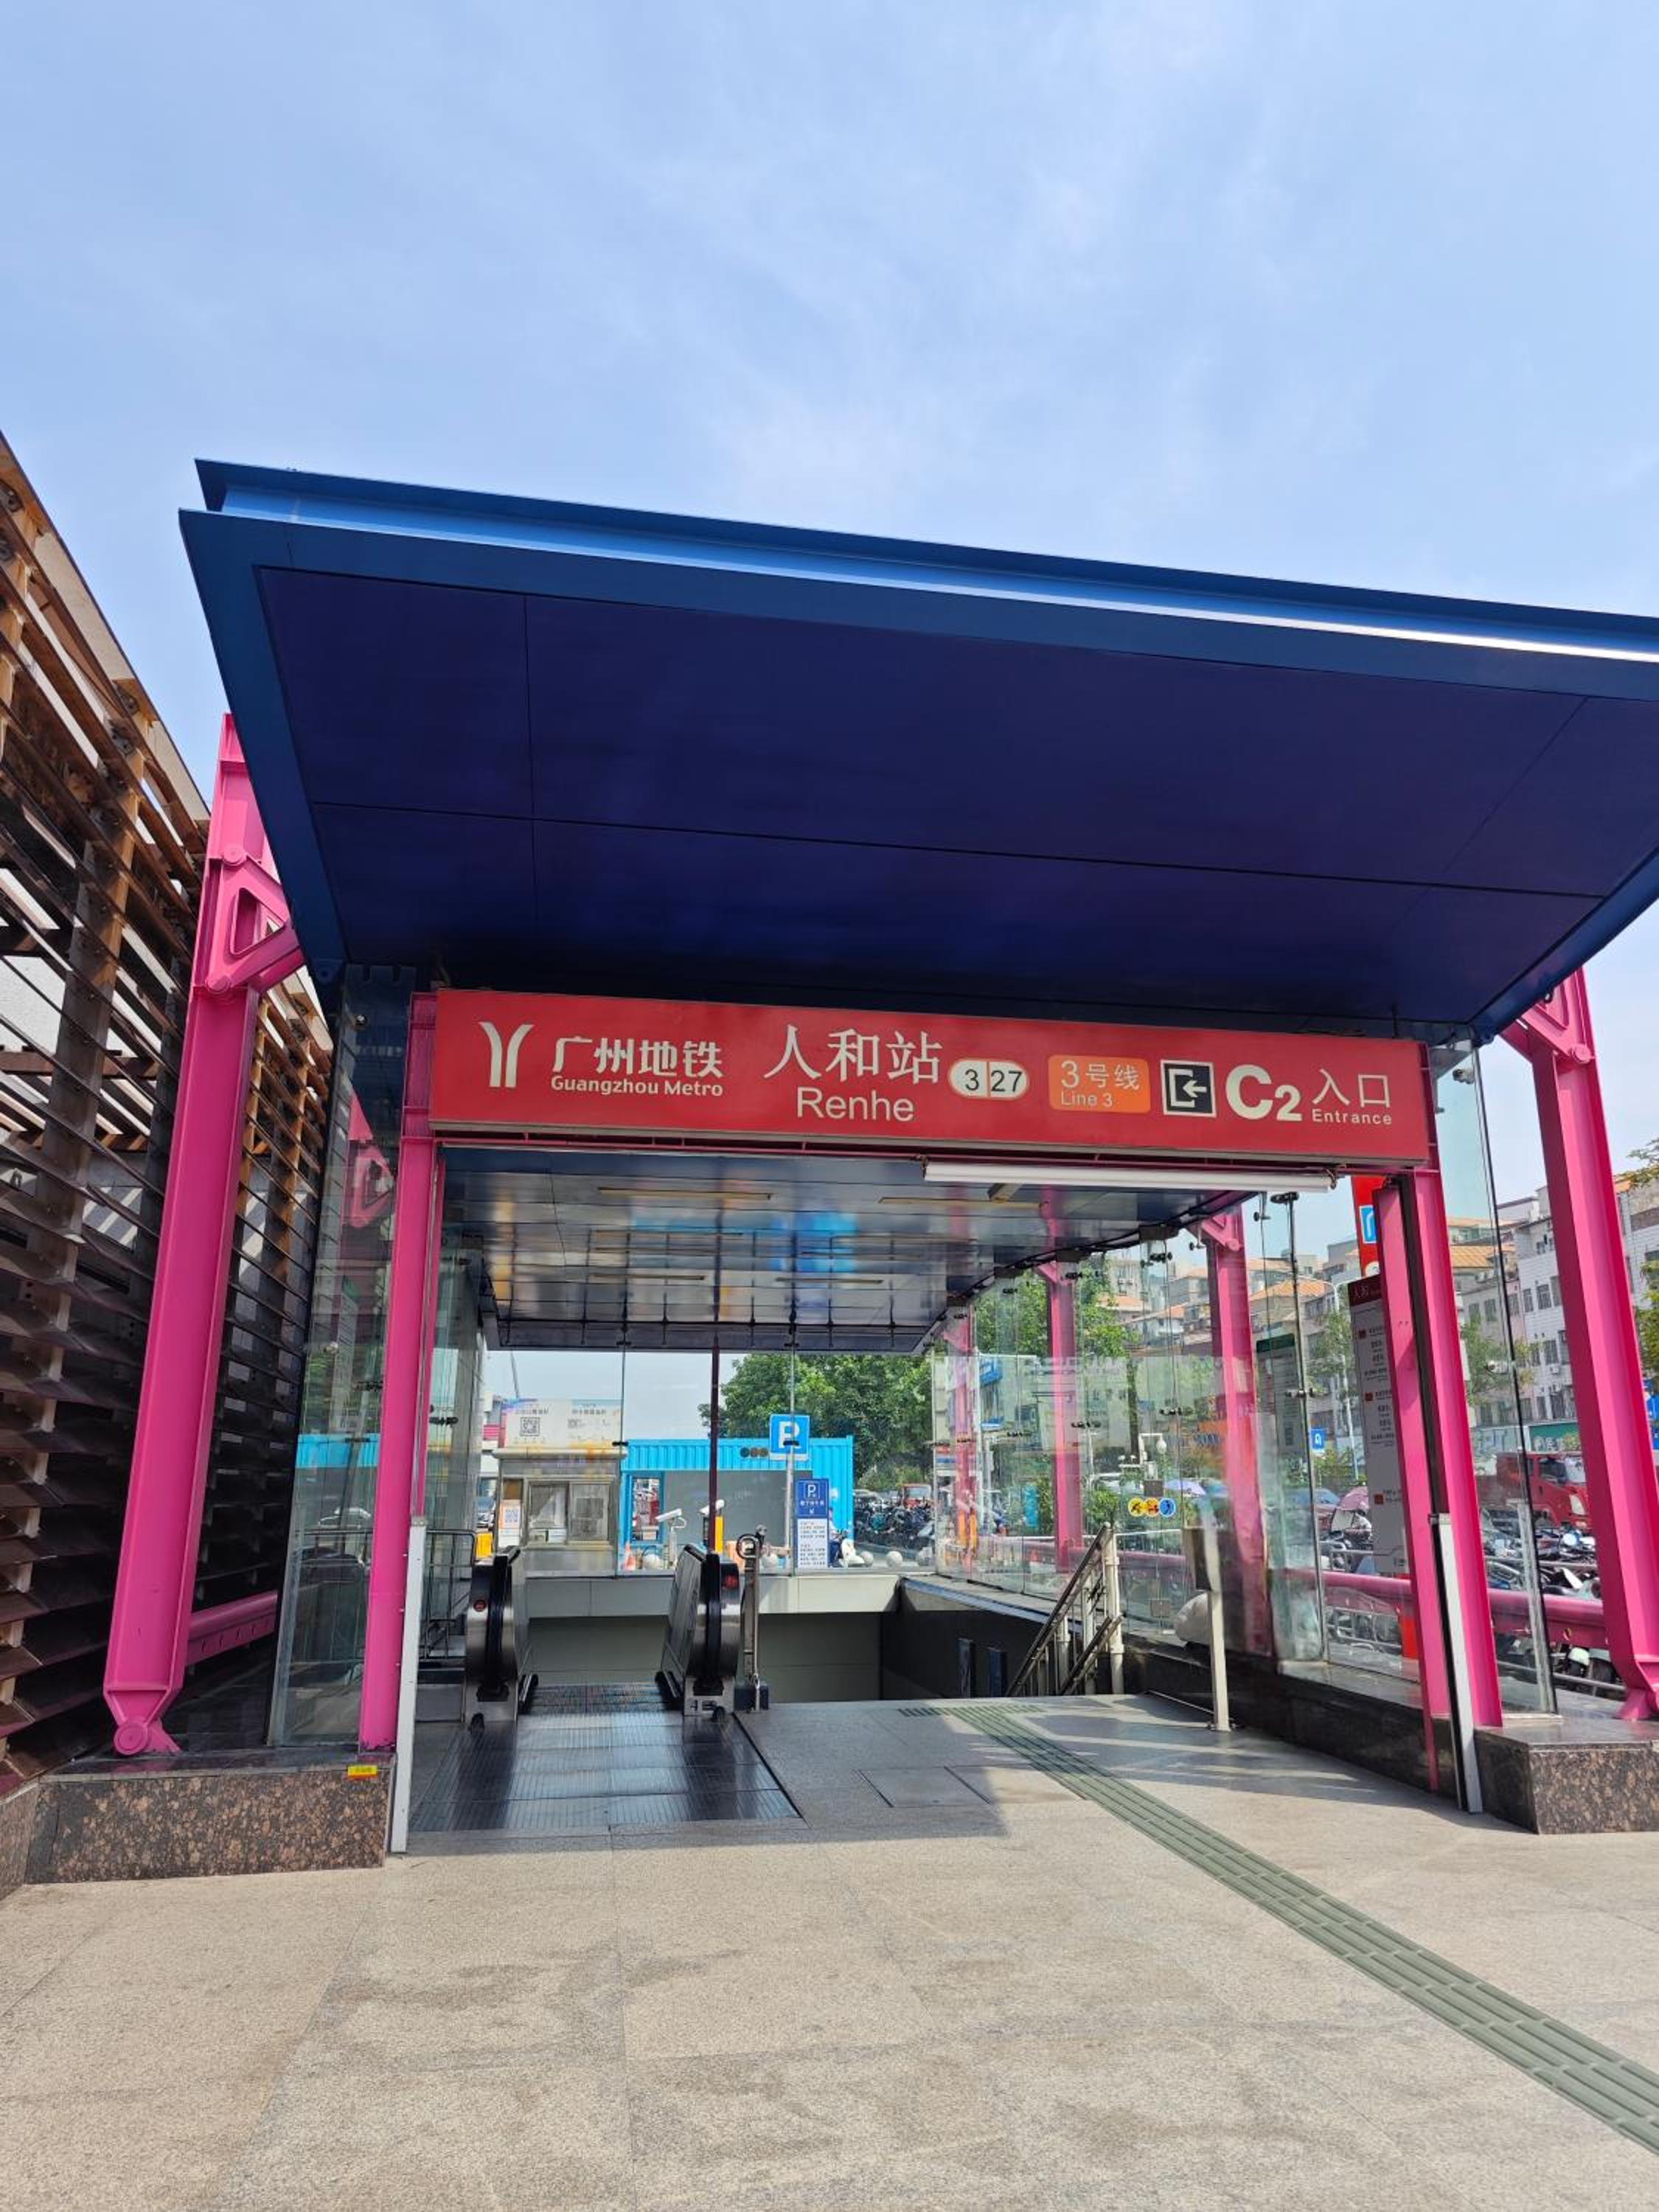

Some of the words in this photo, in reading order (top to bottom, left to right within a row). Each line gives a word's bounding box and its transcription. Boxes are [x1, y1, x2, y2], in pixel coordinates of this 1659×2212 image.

[552, 1036, 724, 1078] 广州地铁
[763, 1024, 943, 1085] 人和站
[551, 1075, 658, 1096] Guangzhou
[664, 1079, 724, 1097] Metro
[1060, 1060, 1141, 1091] 3号线
[1225, 1064, 1303, 1121] C2
[1311, 1068, 1391, 1108] 入口
[796, 1086, 914, 1122] Renhe
[1060, 1091, 1098, 1107] Line
[1102, 1093, 1114, 1107] 3
[1311, 1108, 1392, 1125] Entrance
